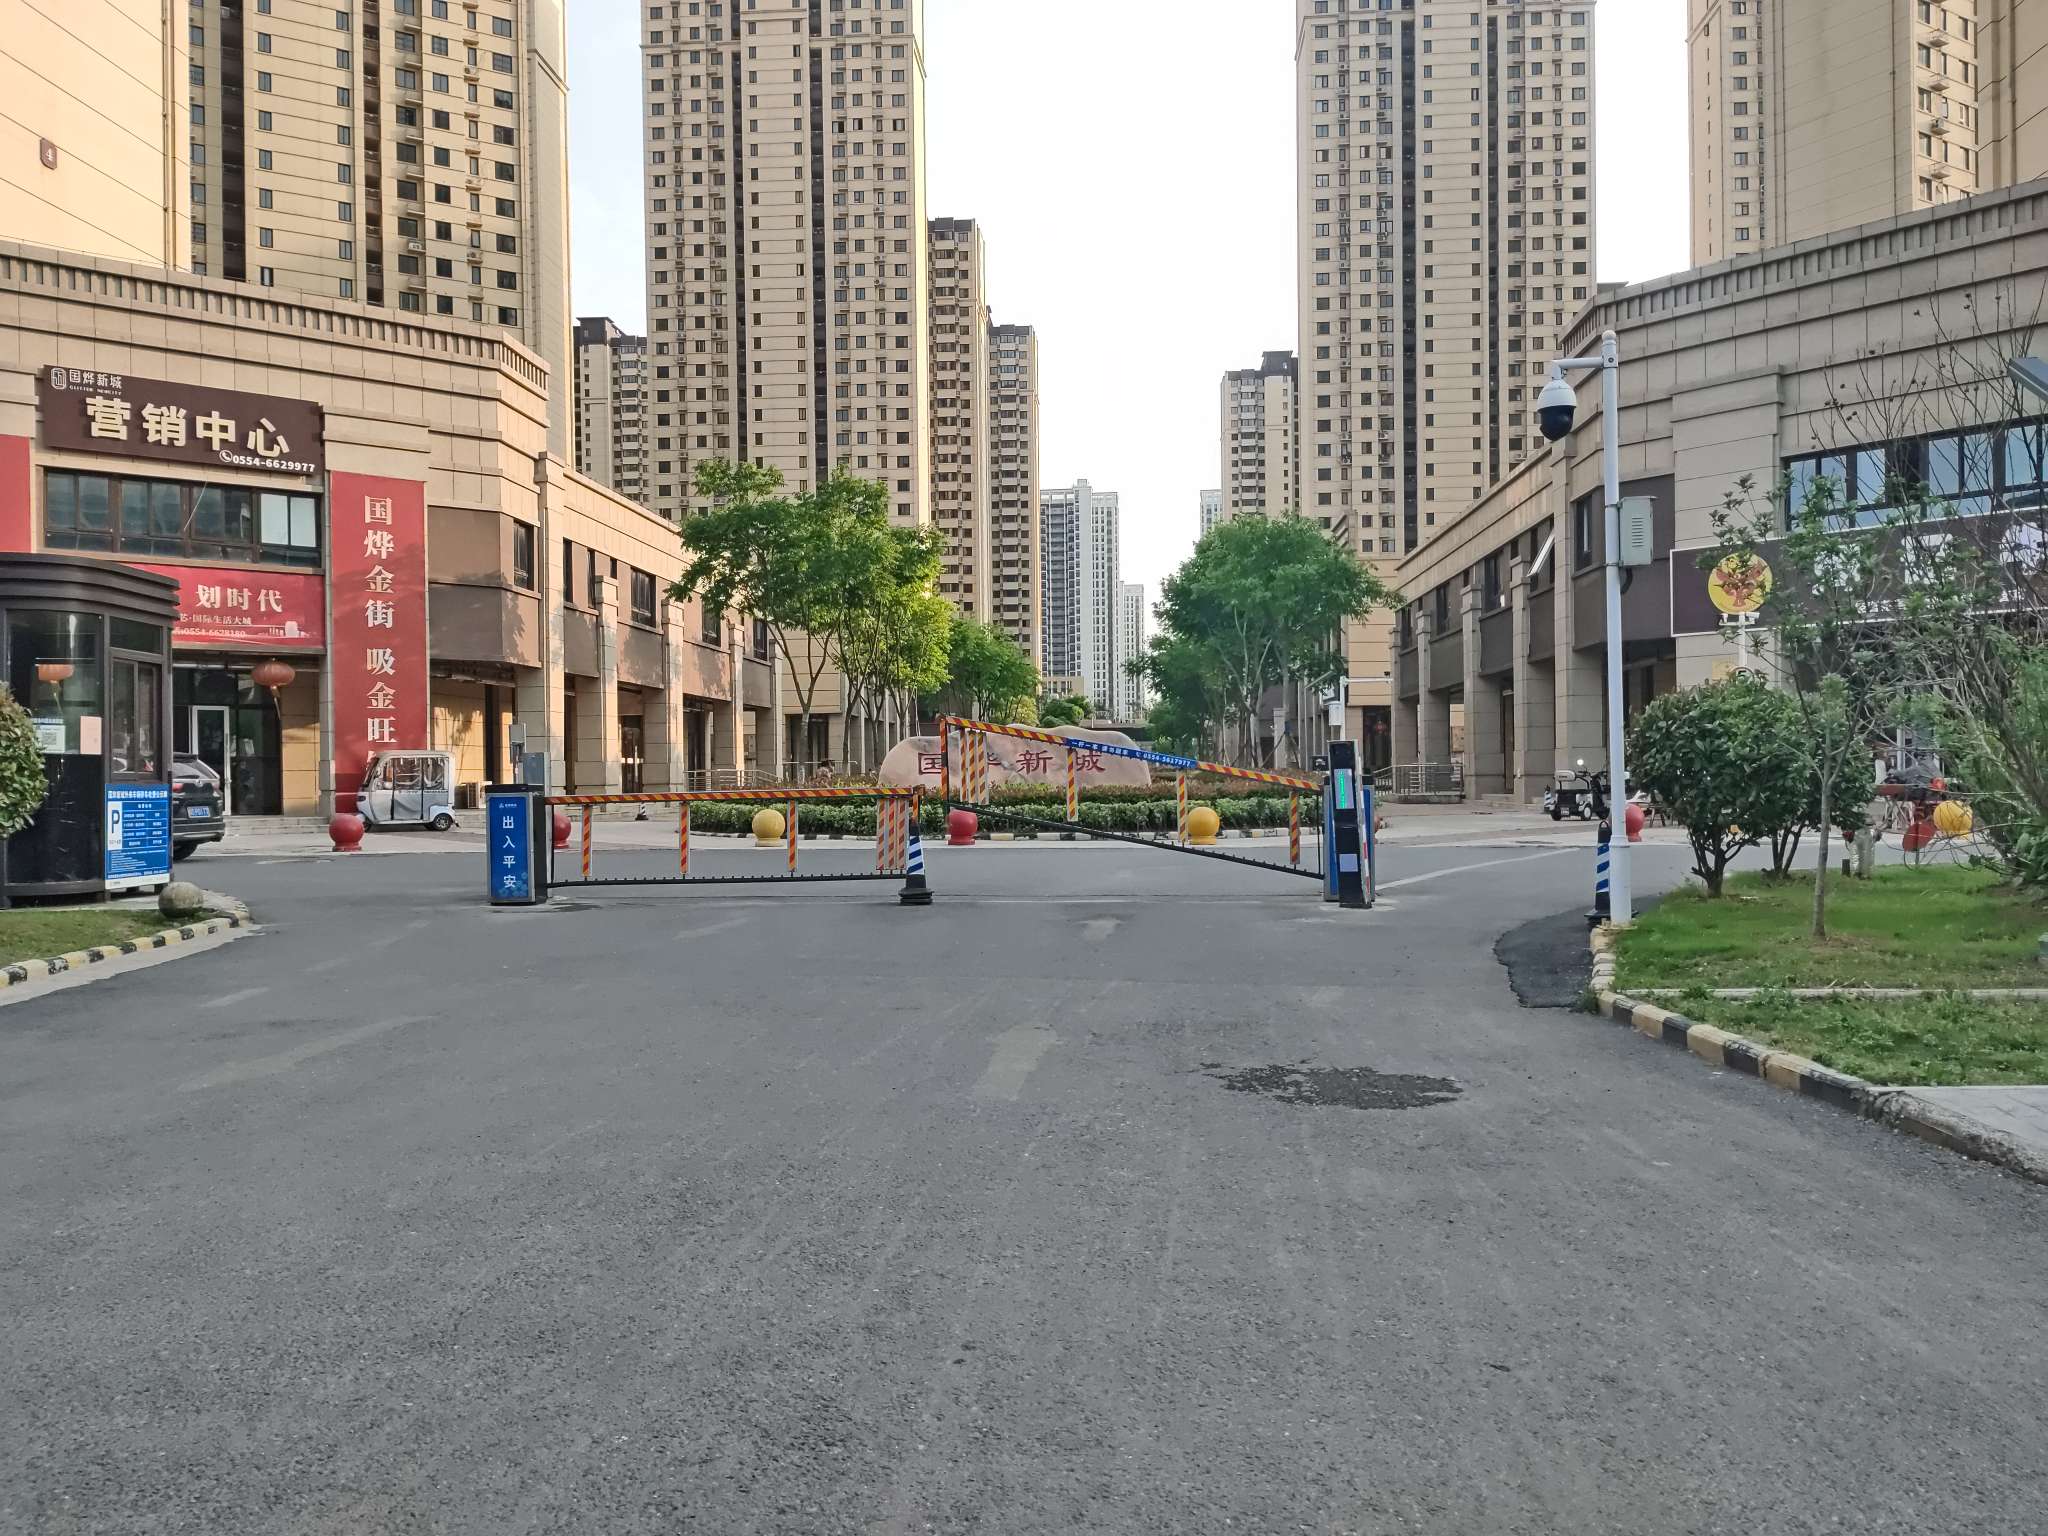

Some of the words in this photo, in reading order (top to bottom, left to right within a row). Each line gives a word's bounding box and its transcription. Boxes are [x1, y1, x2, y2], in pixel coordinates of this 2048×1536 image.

[69, 369, 122, 389] 国烨新城
[85, 396, 290, 458] 营销中心
[232, 455, 316, 473] 0554-6629977
[363, 495, 395, 629] 国烨金街
[195, 584, 283, 613] 划时代
[366, 647, 397, 768] 吸金旺
[502, 815, 516, 889] 出入平安
